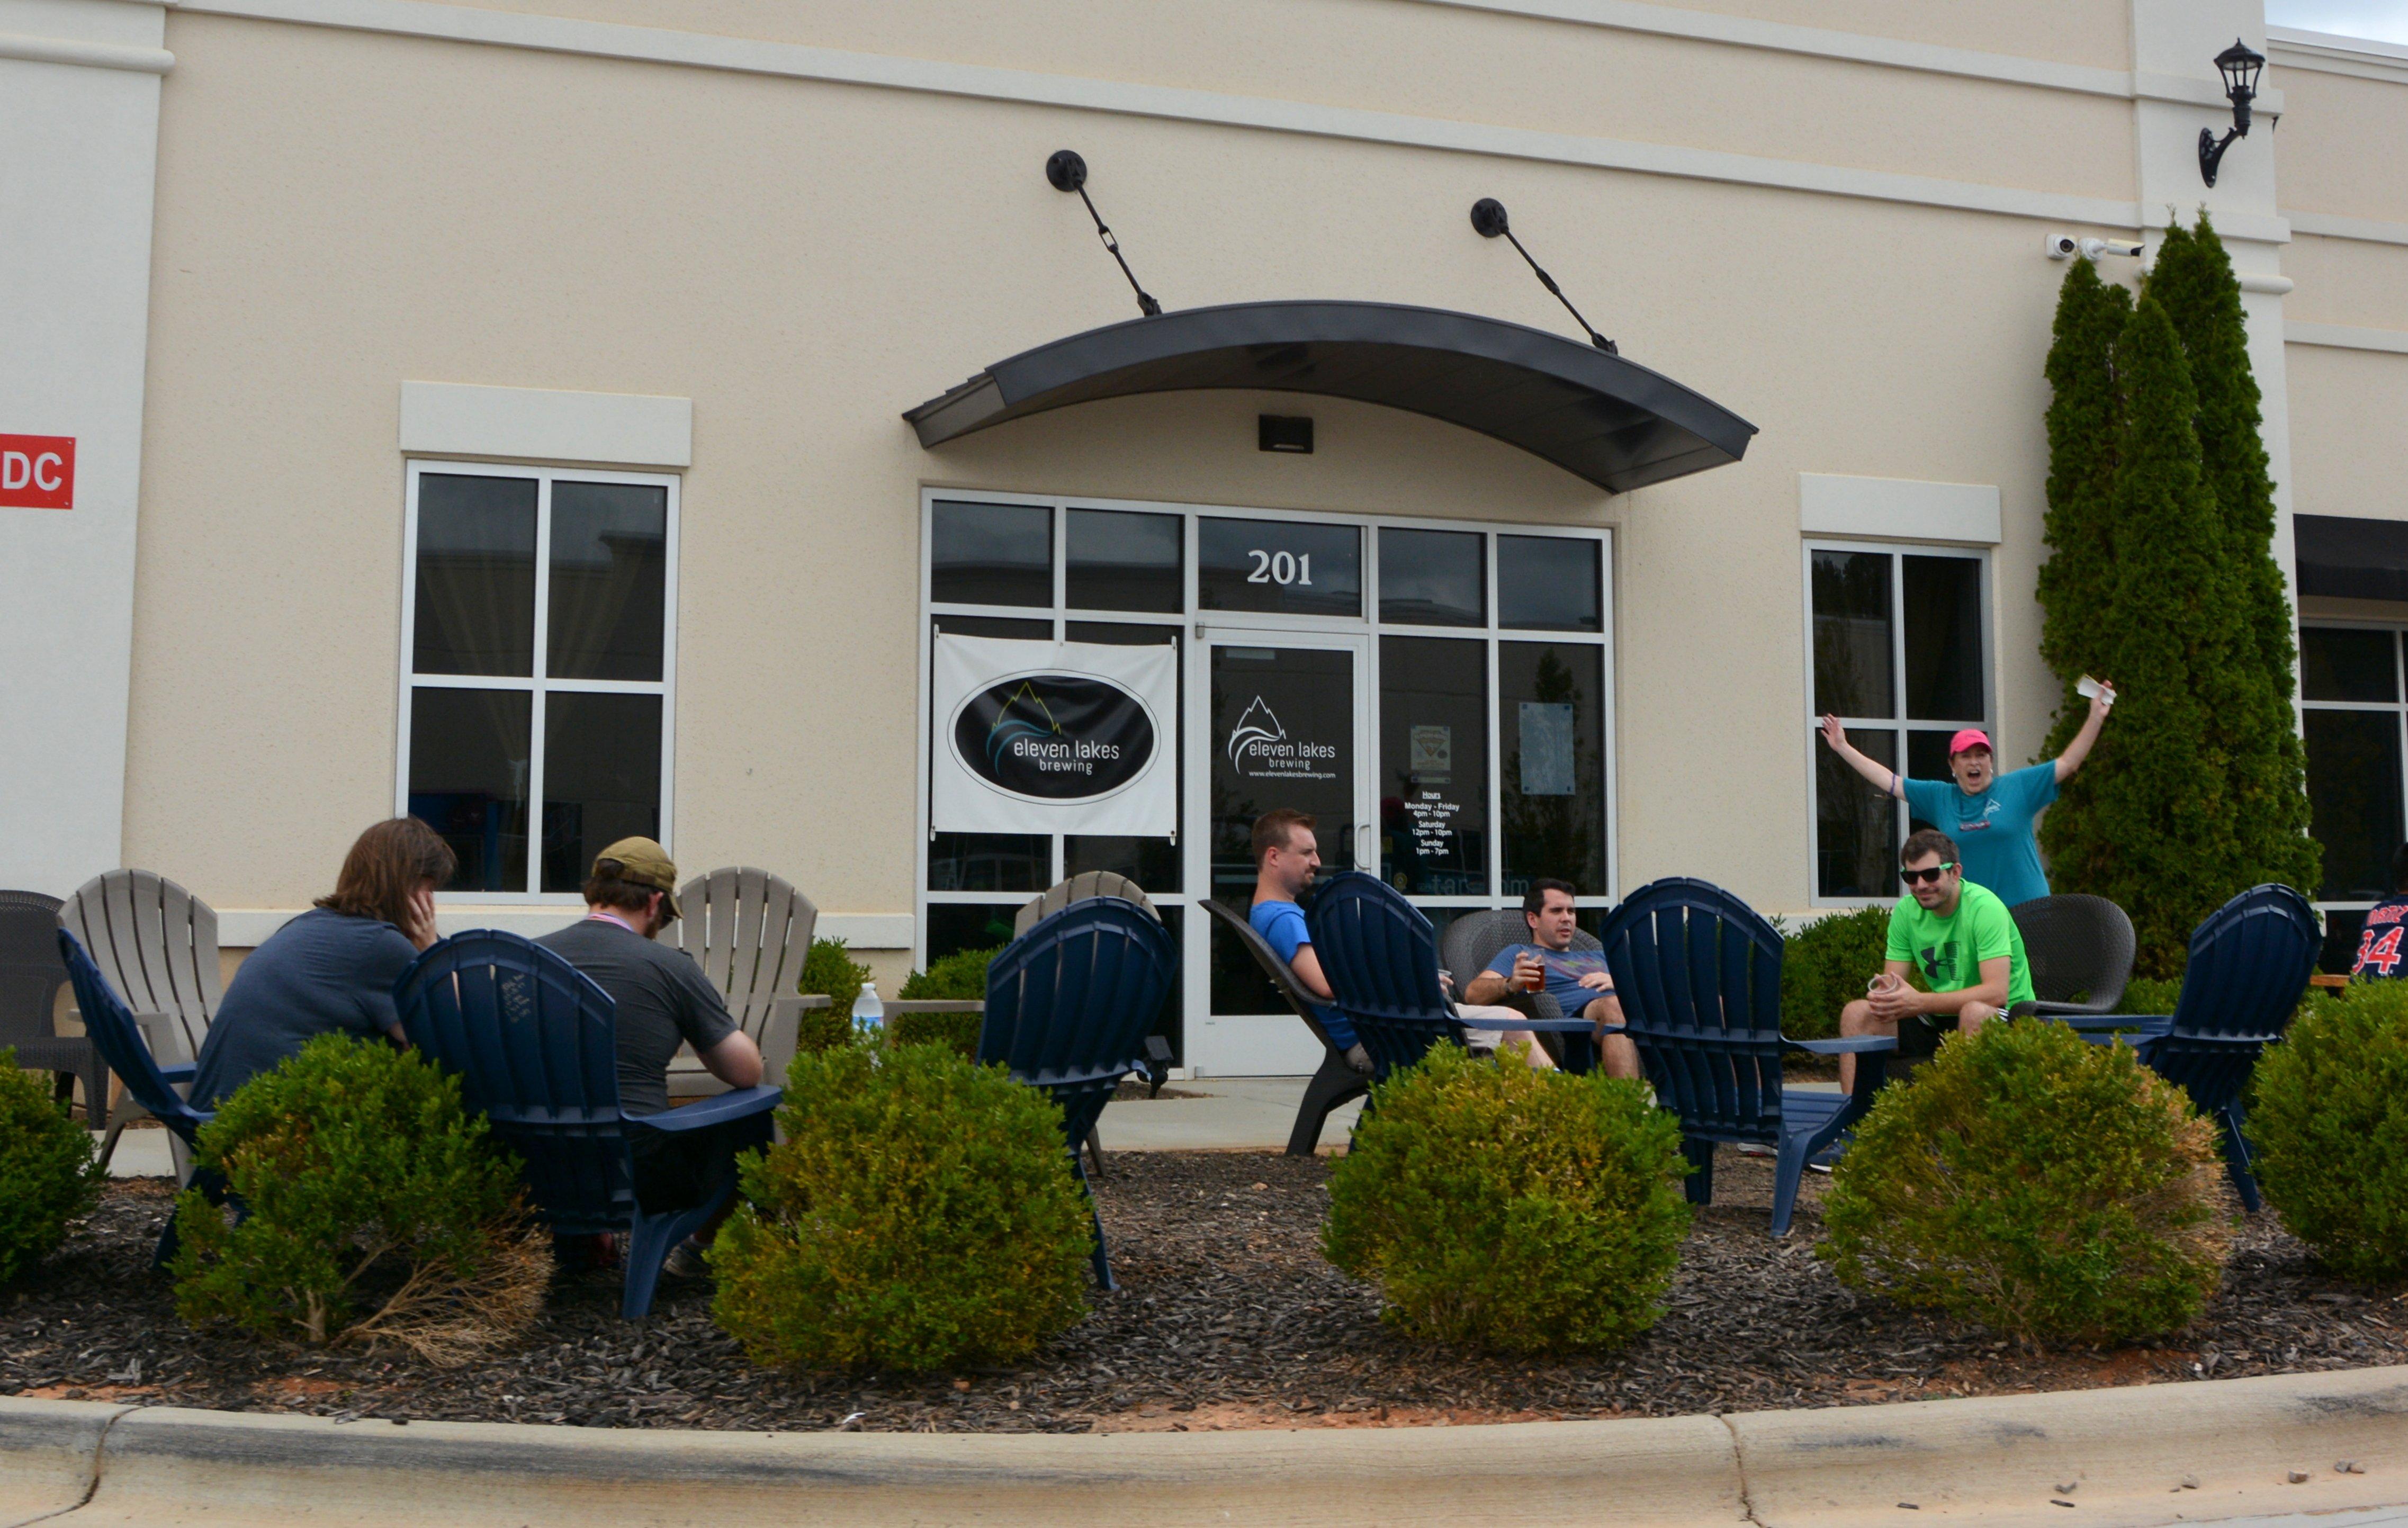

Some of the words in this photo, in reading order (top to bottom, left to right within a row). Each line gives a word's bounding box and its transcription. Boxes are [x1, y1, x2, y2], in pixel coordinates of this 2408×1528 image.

[3, 451, 63, 491] DC
[1247, 550, 1312, 585] 201
[1013, 738, 1070, 758] eleven
[1075, 740, 1120, 759] lakes
[1249, 741, 1294, 757] eleven
[1299, 741, 1335, 758] lakes
[1039, 758, 1093, 776] brewing
[1269, 757, 1311, 771] brewing
[1248, 770, 1336, 780] www.elevenlakesbrewing.com
[1422, 791, 1441, 799] Hours
[1404, 802, 1432, 811] Monday
[1437, 803, 1460, 812] Friday
[1413, 810, 1428, 819] 4pm
[1432, 810, 1451, 819] 10pm
[1418, 821, 1446, 830] Saturday
[1412, 828, 1430, 837] 12pm
[1435, 829, 1452, 837] 10pm
[1421, 839, 1444, 848] Sunday
[1416, 847, 1430, 856] 1pm
[1434, 848, 1449, 856] 7pm
[2352, 927, 2404, 975] 34
